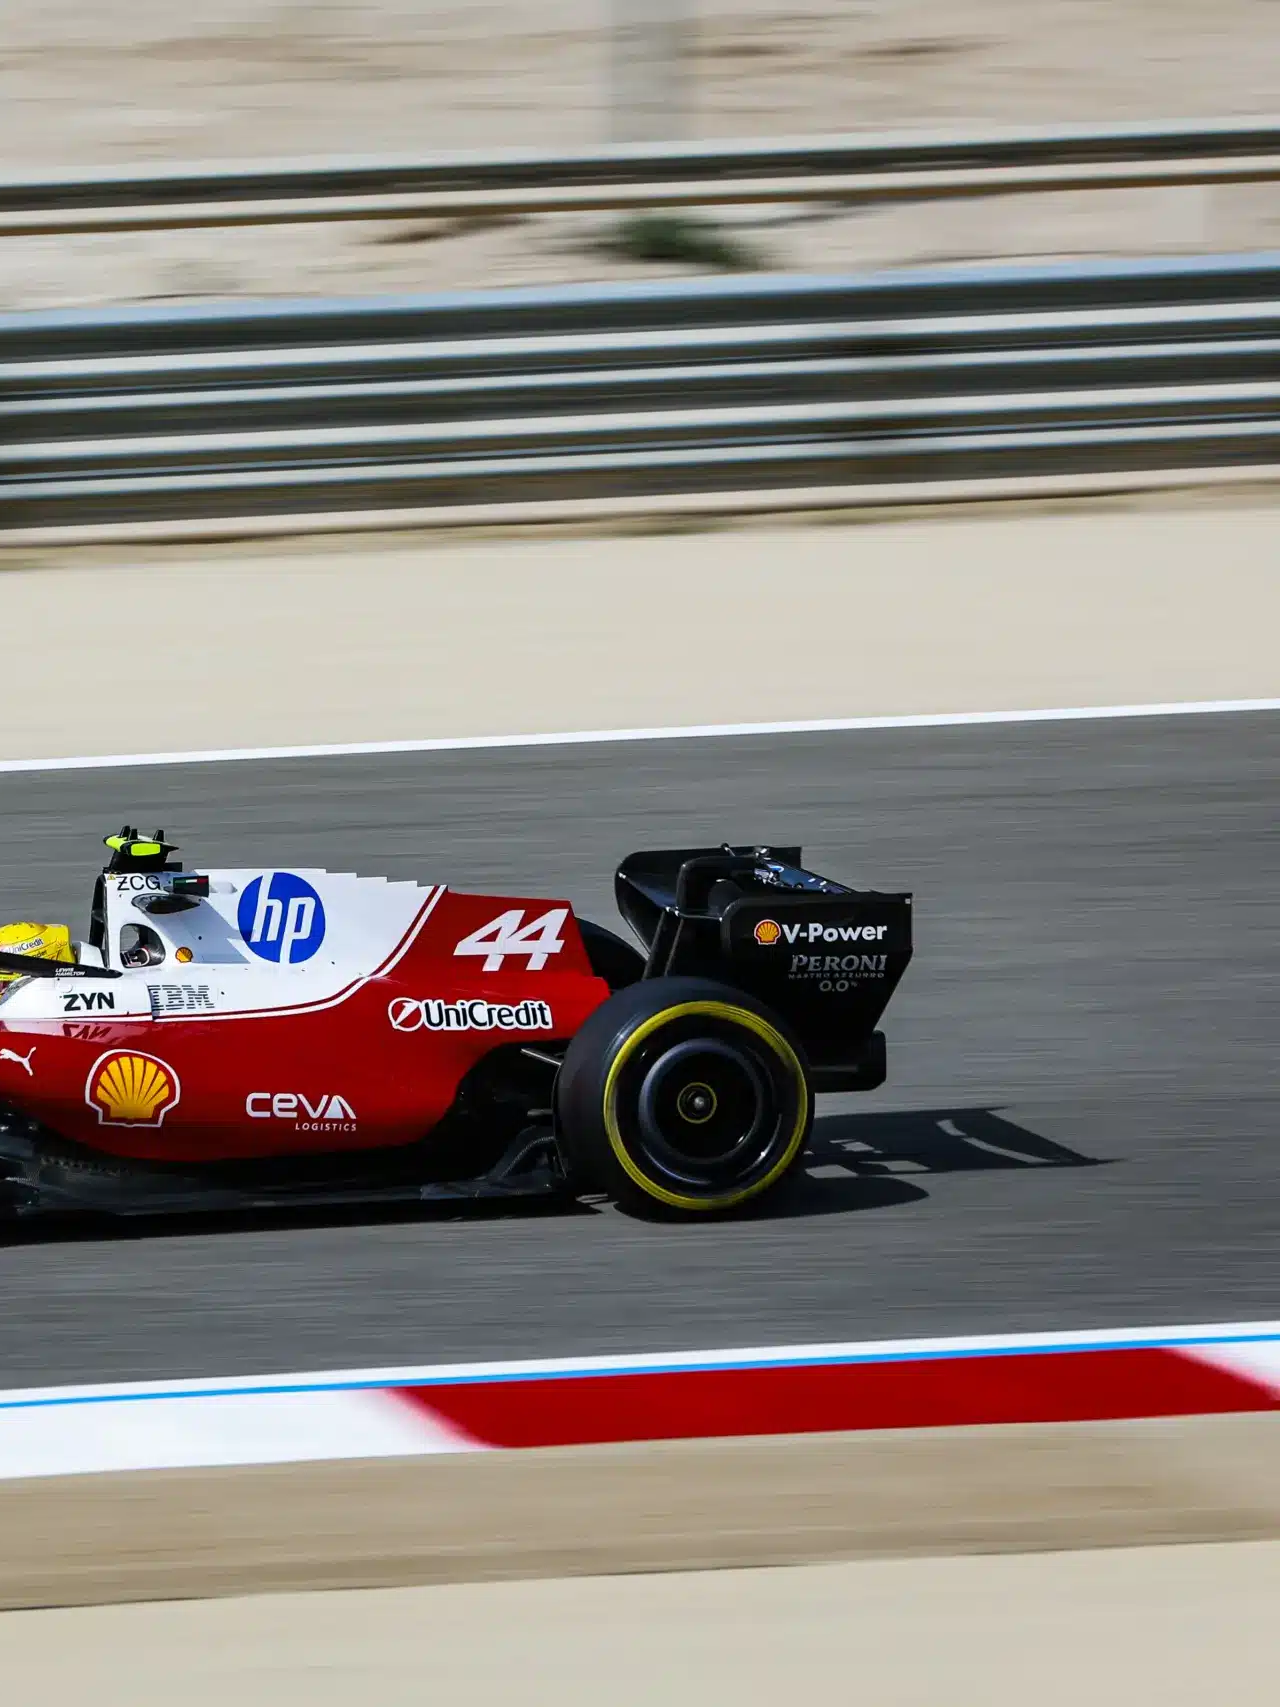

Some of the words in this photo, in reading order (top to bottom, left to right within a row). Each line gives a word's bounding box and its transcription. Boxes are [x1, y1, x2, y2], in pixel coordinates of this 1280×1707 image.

[250, 872, 316, 964] hp
[453, 908, 569, 971] 44
[782, 922, 888, 944] V-Power
[790, 954, 888, 972] PERONI
[63, 991, 115, 1012] ZYN
[147, 984, 216, 1011] IBM
[424, 1001, 550, 1027] UniCredit
[295, 1122, 357, 1132] LOGISTICS
